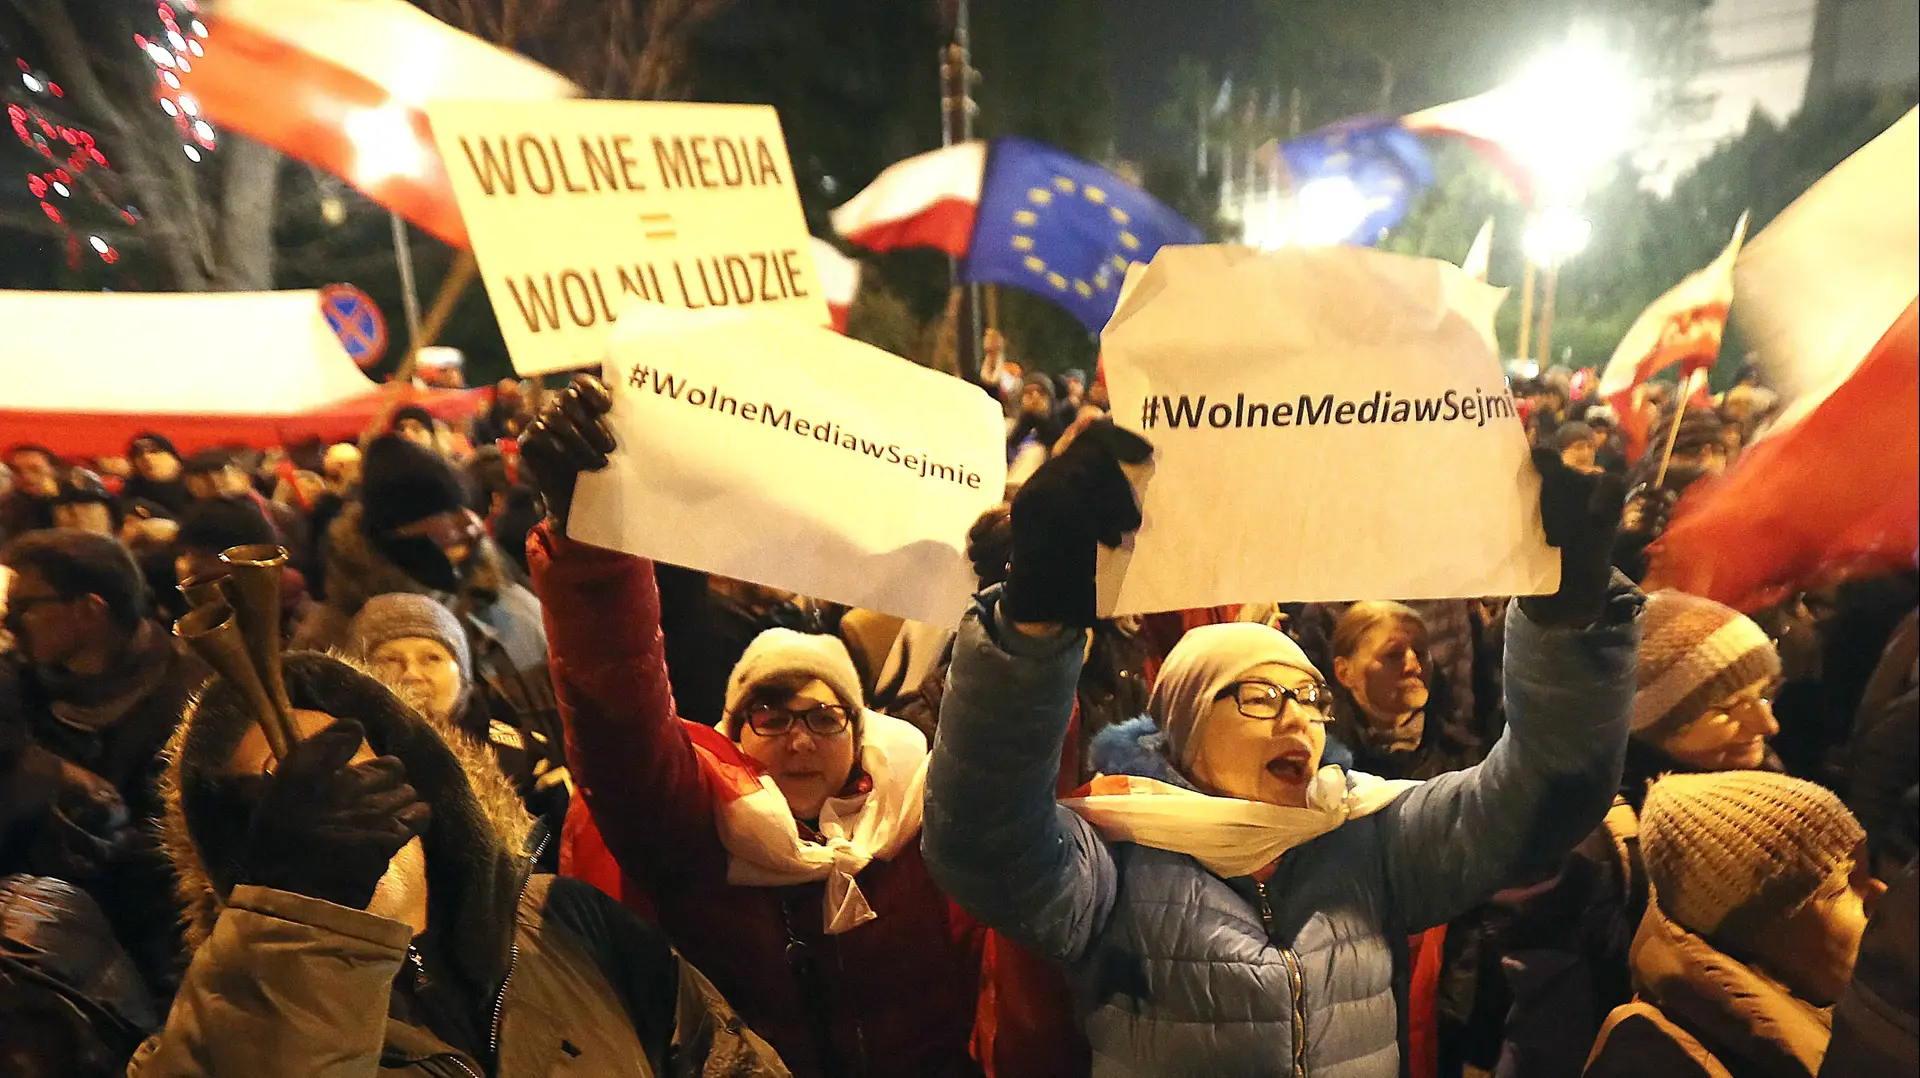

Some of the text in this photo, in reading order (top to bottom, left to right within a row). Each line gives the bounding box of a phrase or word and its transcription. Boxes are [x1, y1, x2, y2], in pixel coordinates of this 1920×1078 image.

[458, 132, 783, 197] WOLNE MEDIA
[674, 249, 809, 309] LUDZIE
[628, 363, 982, 490] #WolneMediawSejmie
[1141, 387, 1516, 430] #WolneMediawSejmi
